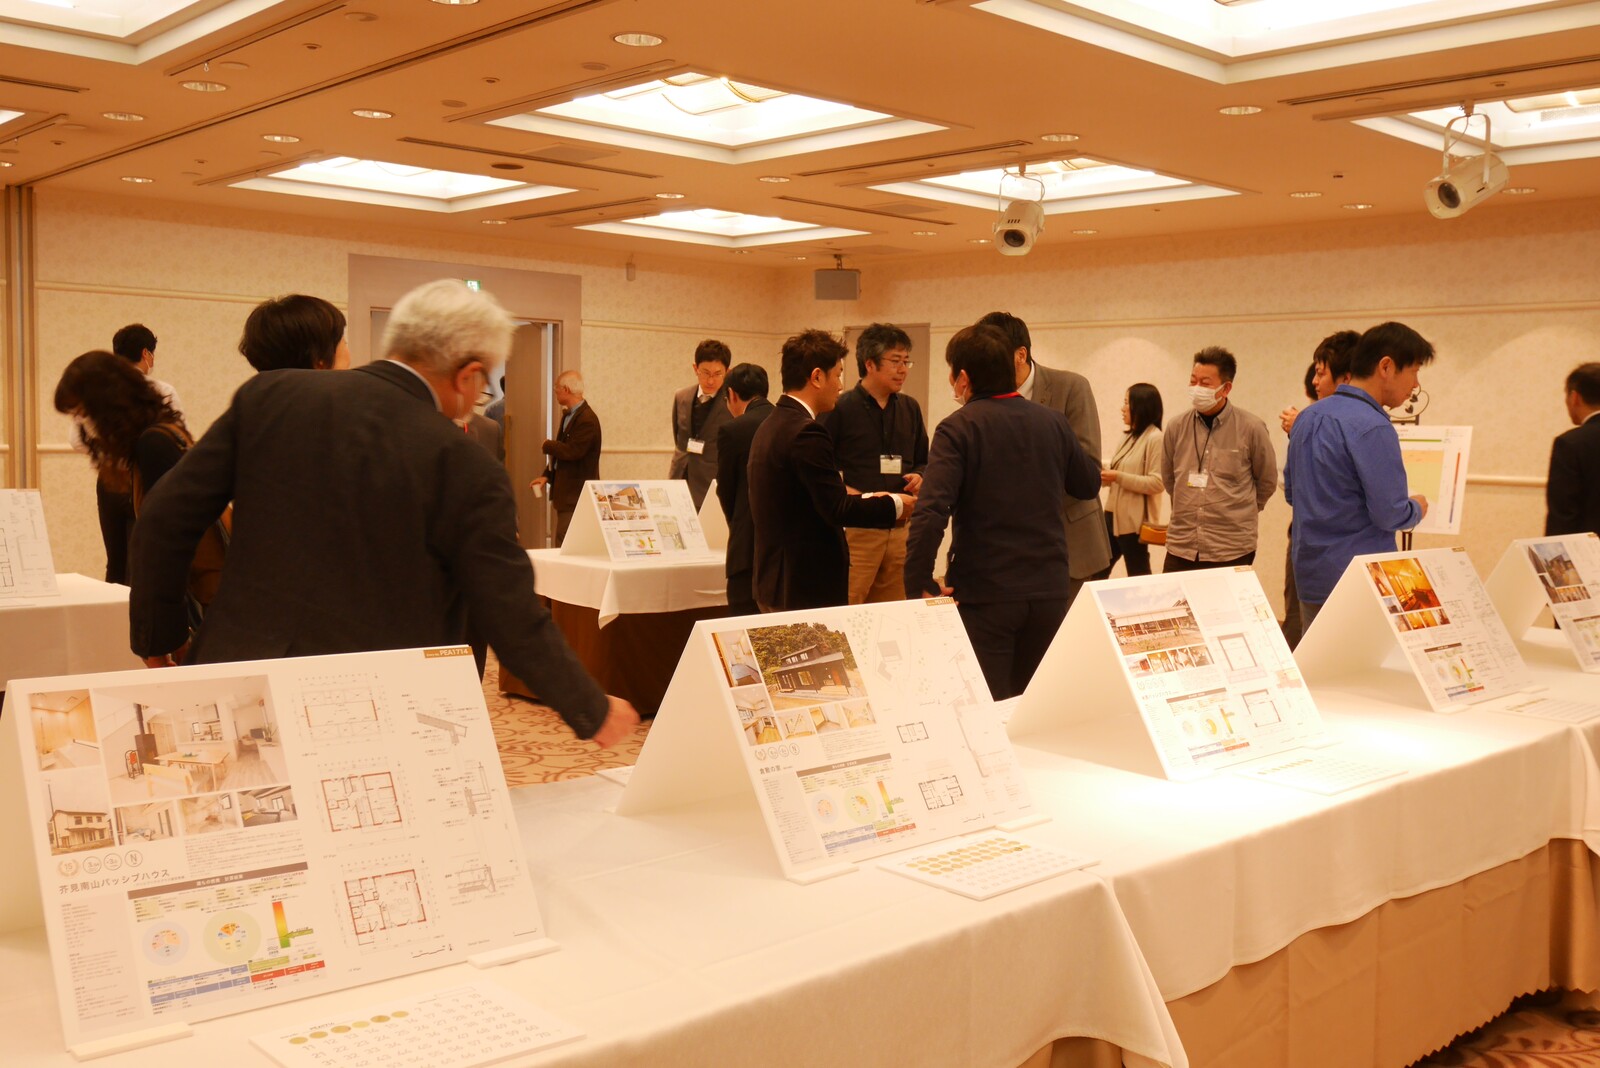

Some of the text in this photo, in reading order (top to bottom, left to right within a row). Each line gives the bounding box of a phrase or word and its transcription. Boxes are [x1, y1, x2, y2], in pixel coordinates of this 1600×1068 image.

[439, 648, 469, 656] PEA1714
[59, 869, 170, 895] 芥見南山パッシブハウス
